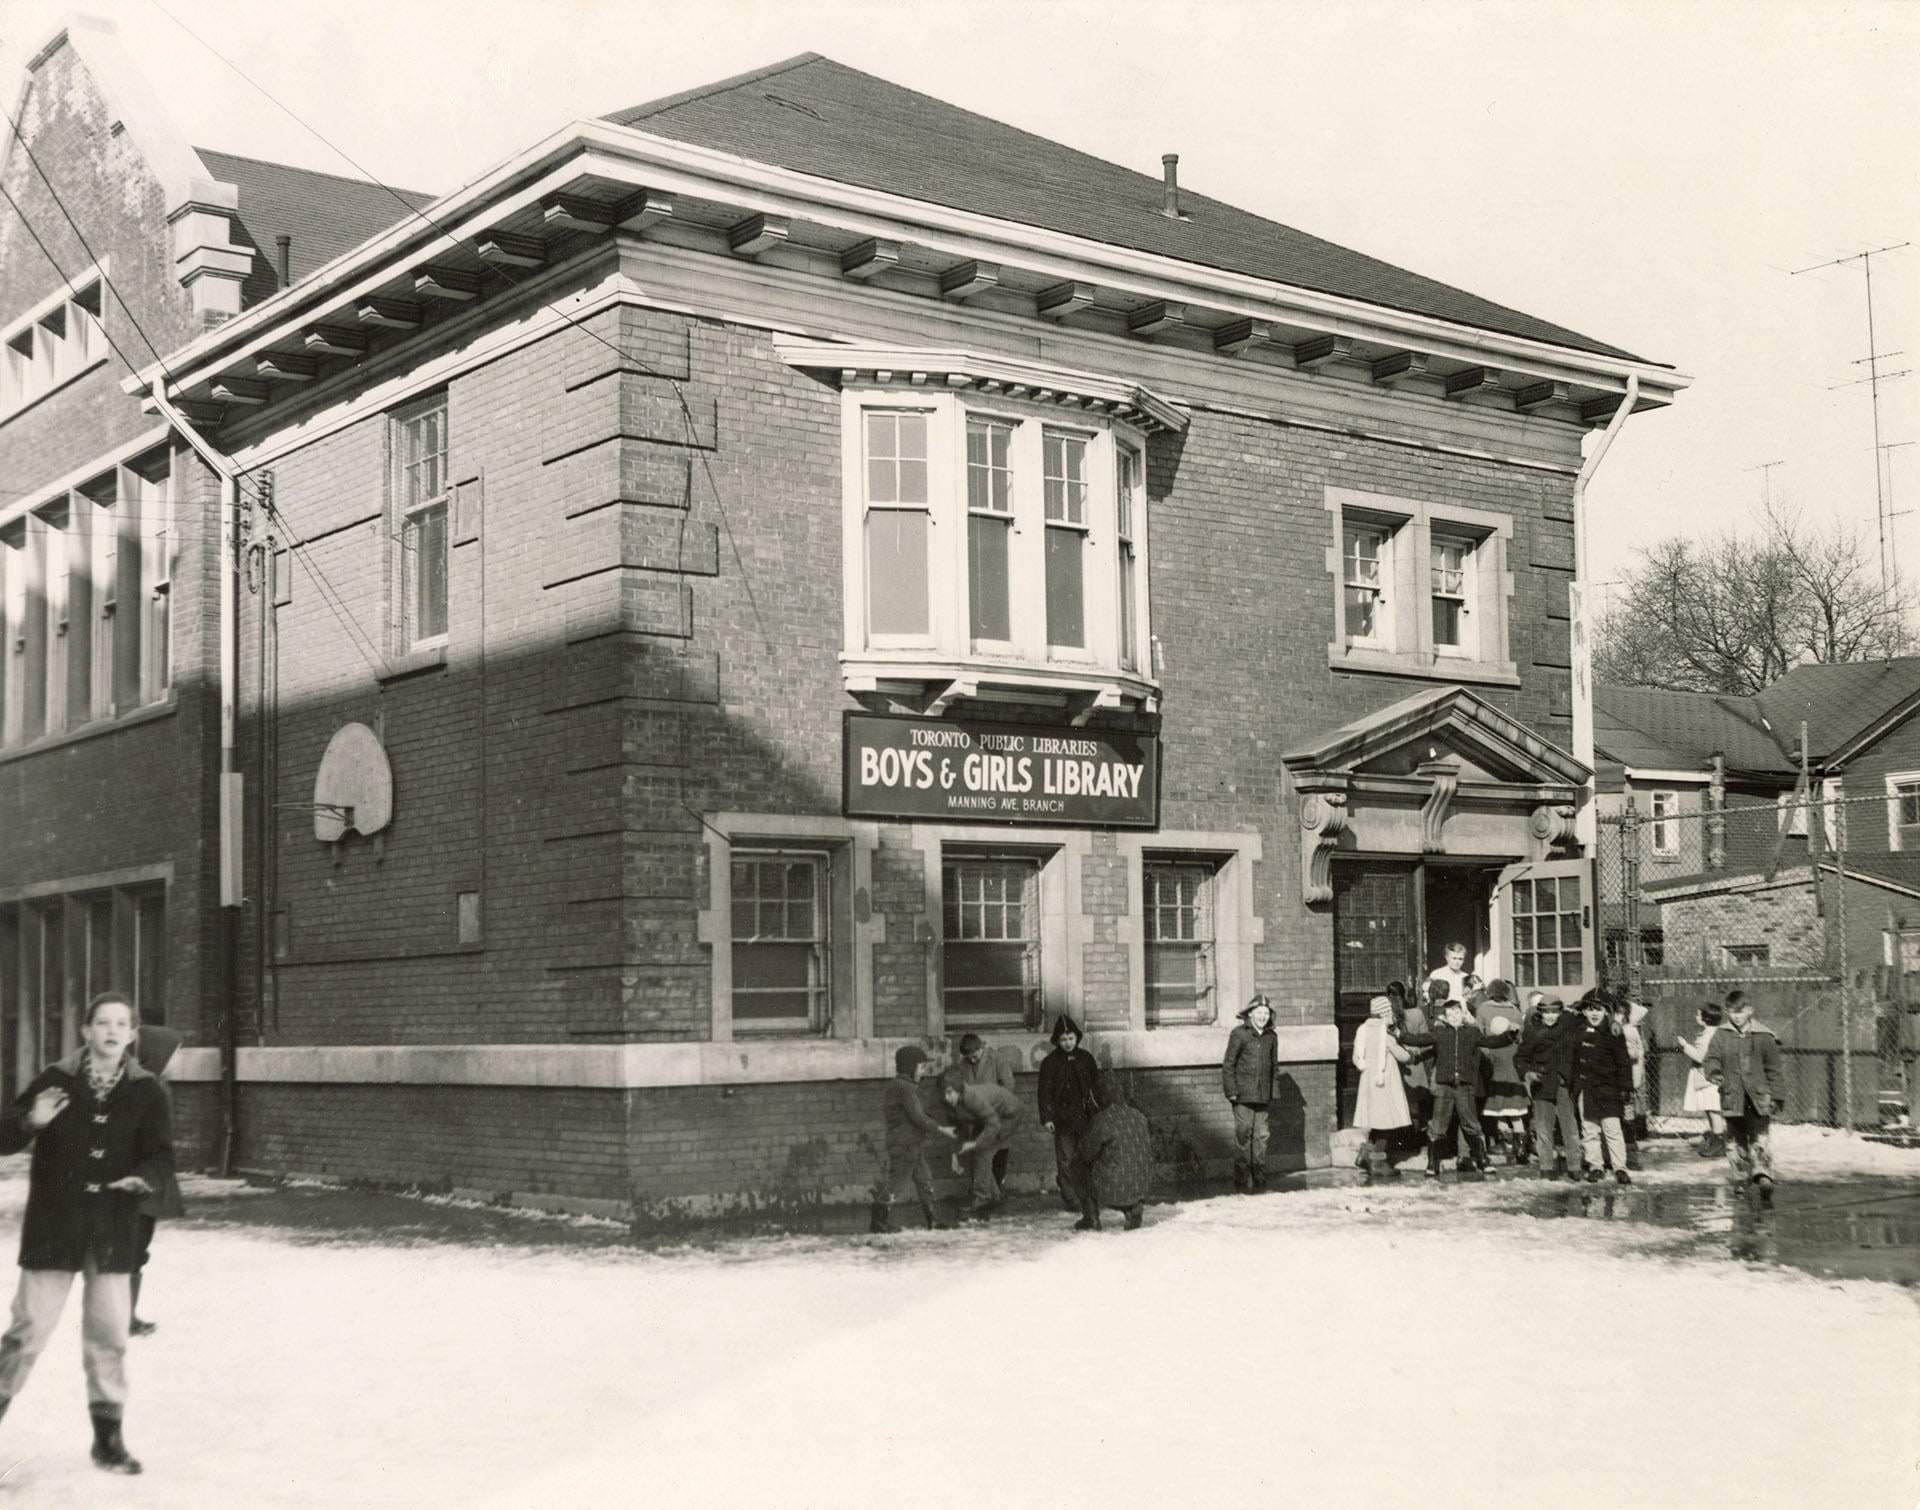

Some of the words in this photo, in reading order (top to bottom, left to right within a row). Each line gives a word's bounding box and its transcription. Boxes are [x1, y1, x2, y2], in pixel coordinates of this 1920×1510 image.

[911, 729, 970, 749] TORONTO
[979, 734, 1024, 751] PUBLIC
[1032, 737, 1097, 757] LIBRARIES
[861, 746, 933, 789] BOYS
[940, 757, 956, 789] &
[963, 754, 1033, 793] GIRLS
[1044, 760, 1144, 799] LIBRARY
[947, 795, 996, 810] MANNING
[1000, 799, 1020, 811] AVE.
[1023, 799, 1065, 813] BRANCH
